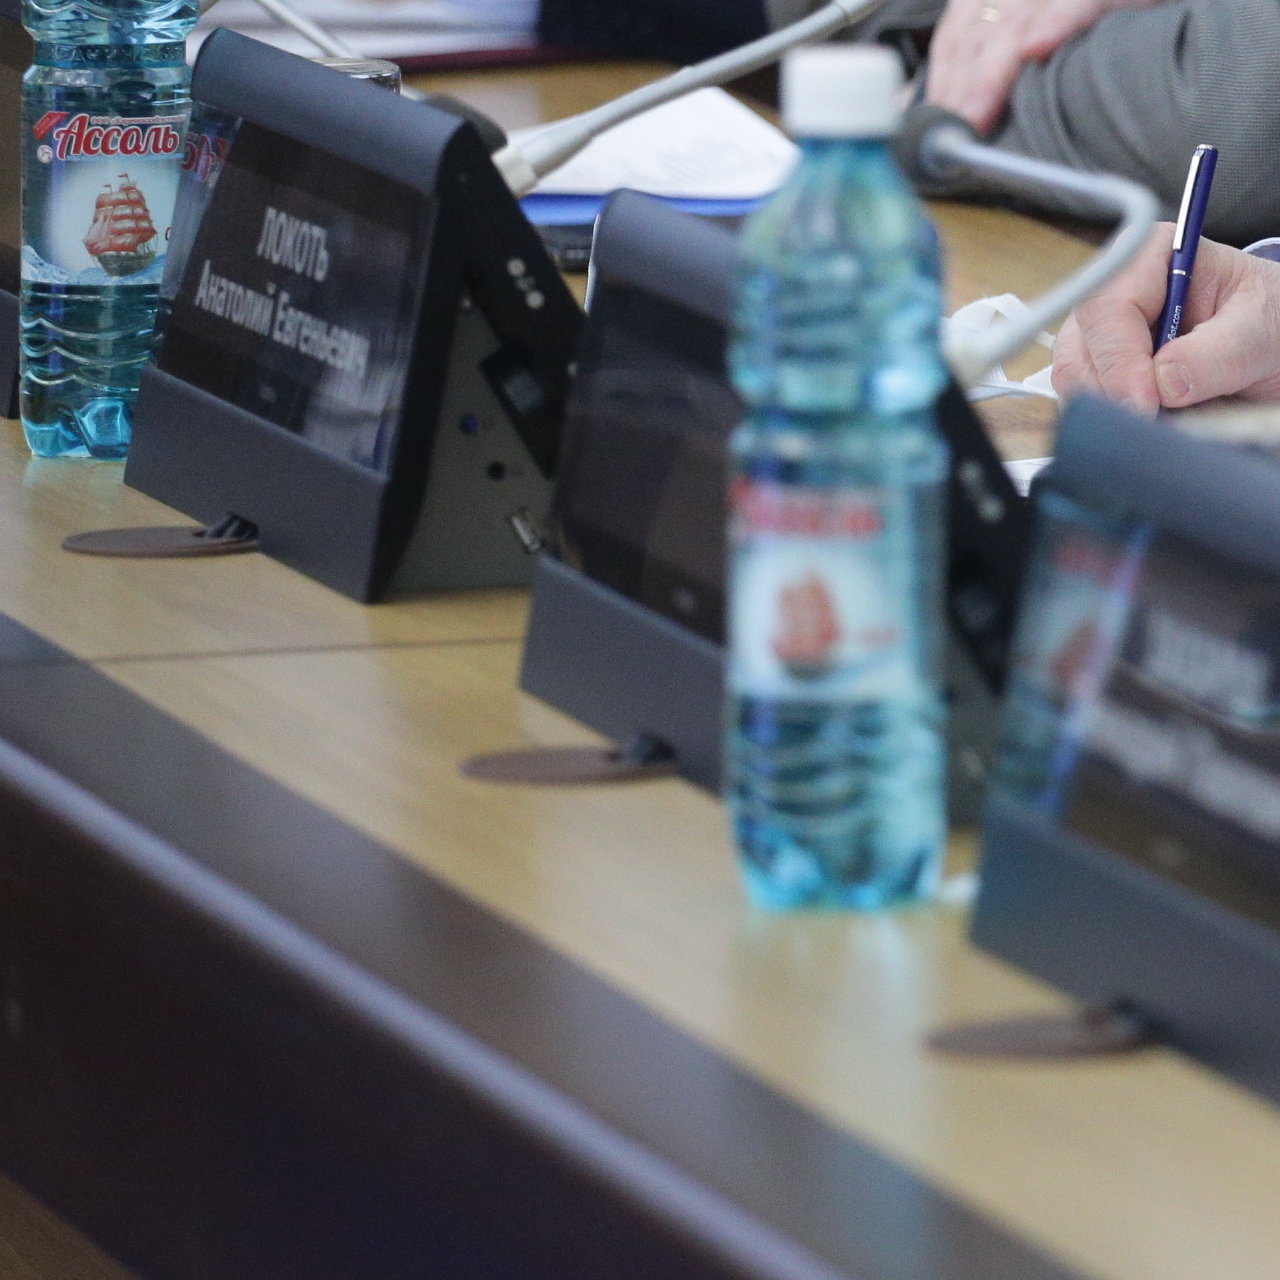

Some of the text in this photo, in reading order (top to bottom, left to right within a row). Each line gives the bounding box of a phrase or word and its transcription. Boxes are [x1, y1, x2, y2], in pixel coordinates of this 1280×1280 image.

[54, 114, 180, 160] Ассоль
[256, 206, 330, 282] ЛОКОТЬ
[195, 259, 276, 337] Анатолий
